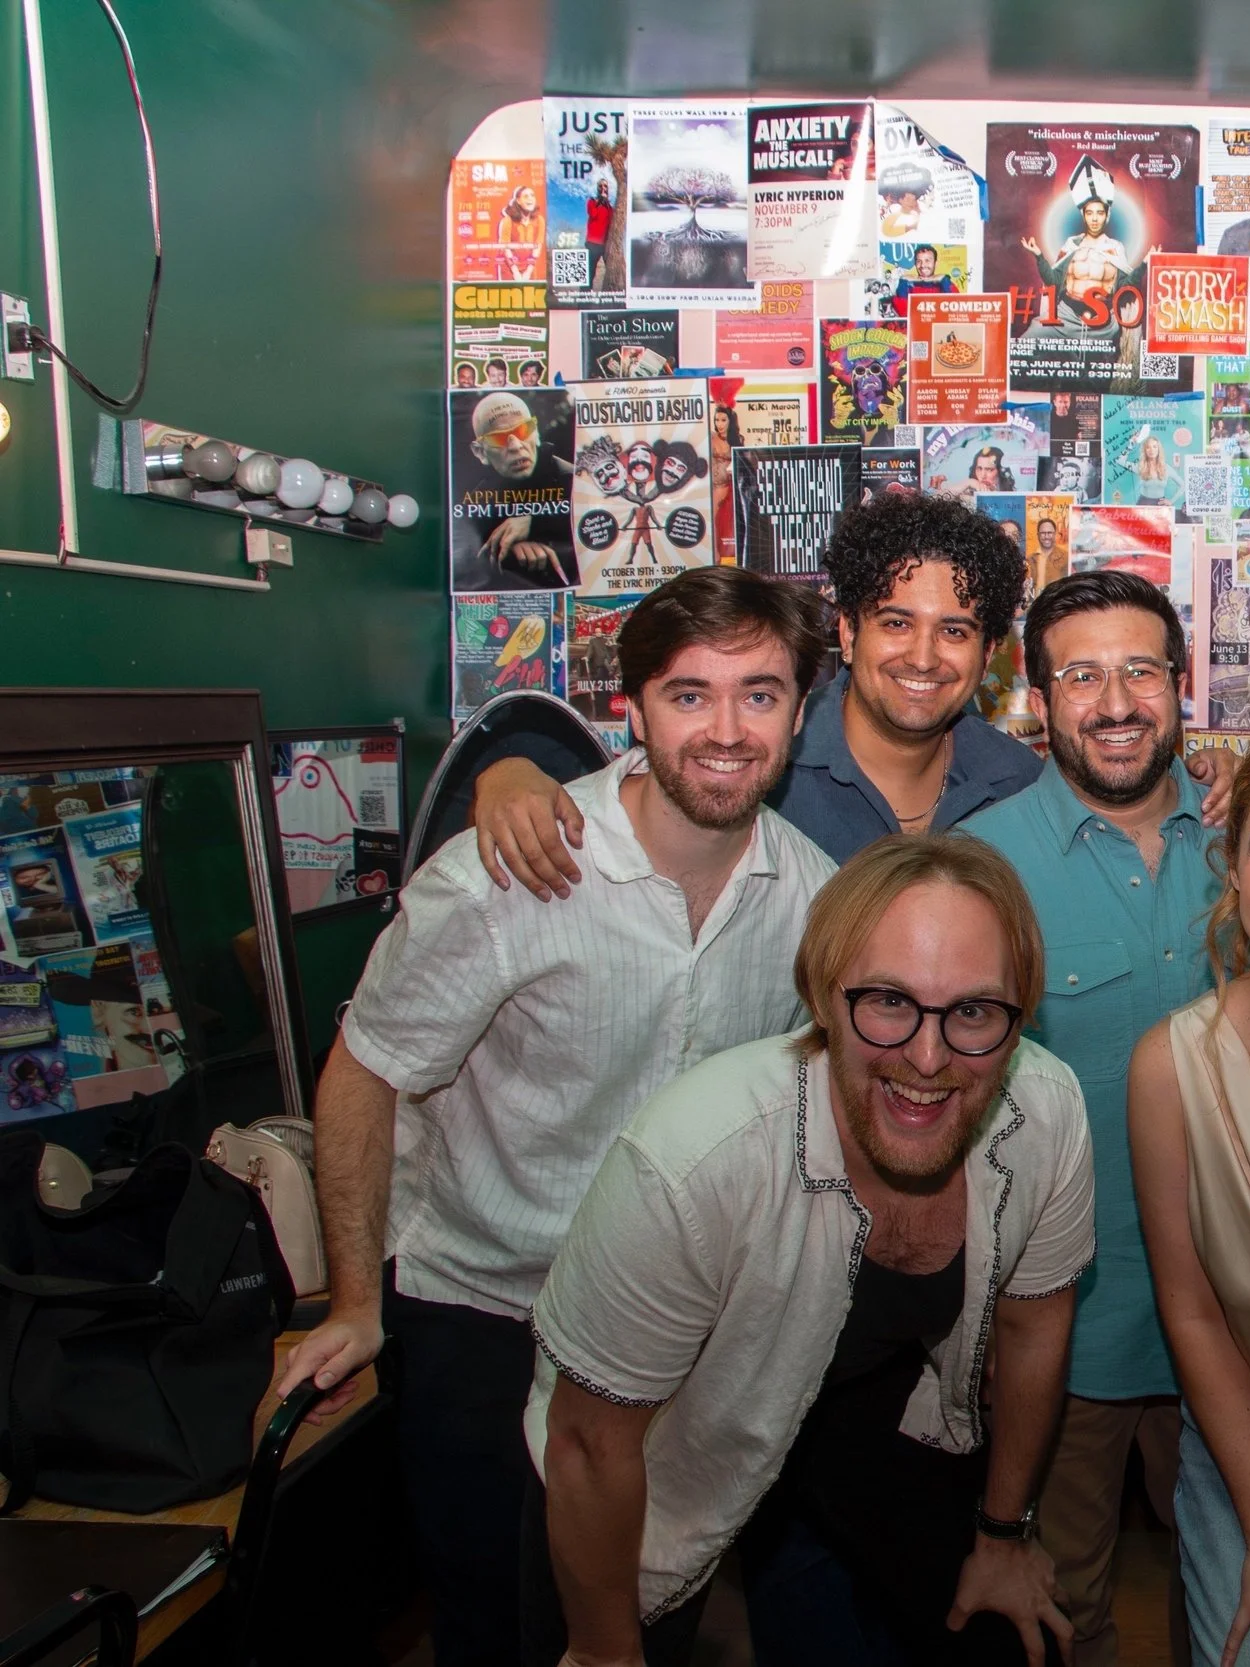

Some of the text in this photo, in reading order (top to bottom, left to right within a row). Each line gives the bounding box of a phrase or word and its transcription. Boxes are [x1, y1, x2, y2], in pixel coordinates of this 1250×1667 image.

[559, 112, 624, 136] JUST
[754, 115, 850, 142] ANXIETY
[1084, 130, 1092, 139] &
[560, 143, 583, 154] THE
[769, 140, 788, 152] THE
[753, 149, 834, 170] MUSICAL!
[560, 160, 593, 180] TIP
[754, 189, 844, 203] LYRIC HYPERION
[754, 202, 818, 215] NOVEMBER 9
[754, 216, 793, 228] 7:30PM
[761, 283, 804, 298] OIDS
[1157, 269, 1233, 304] STORY
[454, 285, 547, 310] Gunk
[916, 301, 1003, 312] 4K COMEDY
[1009, 286, 1064, 328] #1
[1158, 299, 1245, 331] SMASH
[586, 318, 675, 334] Tarot Show
[1155, 334, 1167, 342] THE
[1060, 345, 1116, 353] EDINBURGH
[1030, 361, 1133, 370] JUNE 4TH PM
[1215, 361, 1247, 373] THAT
[1026, 369, 1132, 379] JULY 6TH PM
[656, 397, 704, 422] BASHIO
[771, 403, 801, 411] Maroon
[1128, 410, 1177, 419] BROOKS
[773, 419, 792, 433] BIG
[926, 432, 949, 457] my
[869, 459, 916, 470] For Work
[757, 458, 844, 514] SECONDHAND
[462, 487, 565, 506] APPLEWHITE
[453, 500, 571, 519] 8 PM TUESDAYS
[601, 567, 636, 578] OCTOBER
[637, 566, 655, 576] 19TH
[607, 579, 643, 589] THE LYRIC
[1211, 644, 1248, 655] June 13
[1218, 654, 1240, 664] 9:30
[576, 680, 598, 692] JULY
[220, 1272, 266, 1294] LAWREN
